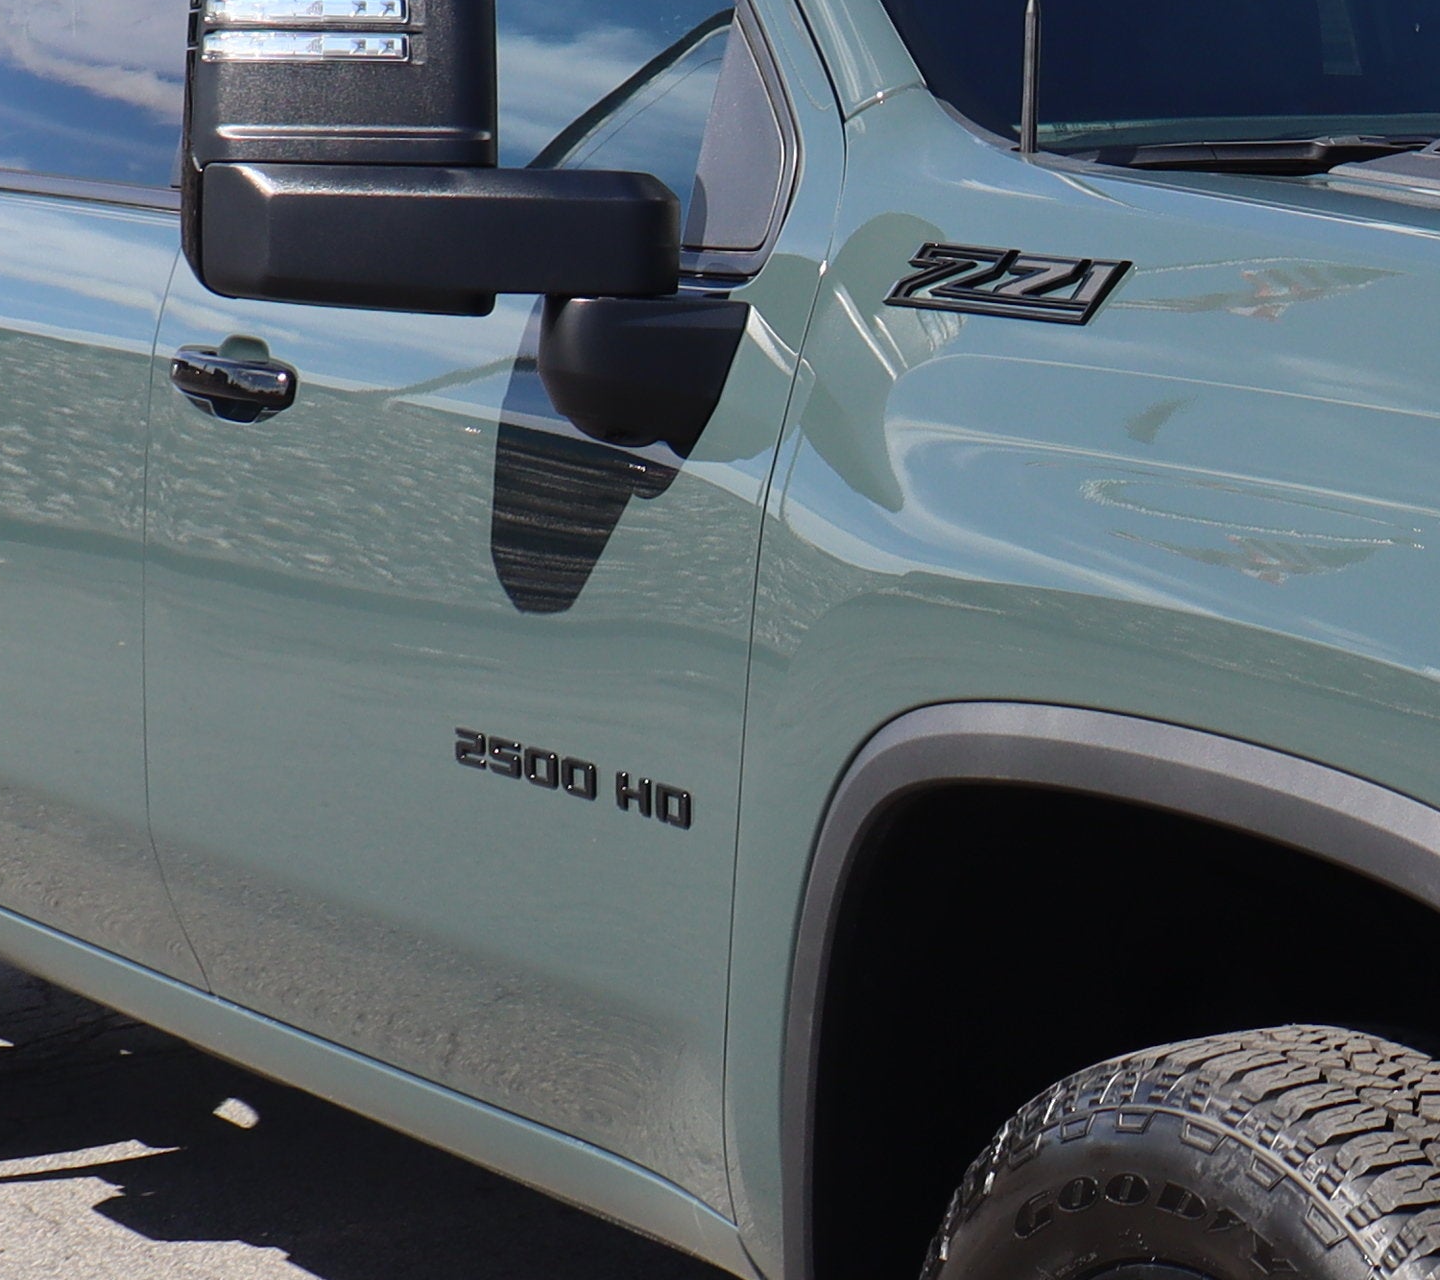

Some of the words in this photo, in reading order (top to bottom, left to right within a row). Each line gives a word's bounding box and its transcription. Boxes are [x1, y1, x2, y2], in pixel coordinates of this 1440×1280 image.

[882, 242, 1134, 327] Z71
[454, 726, 598, 802] 2500
[615, 770, 693, 831] HD
